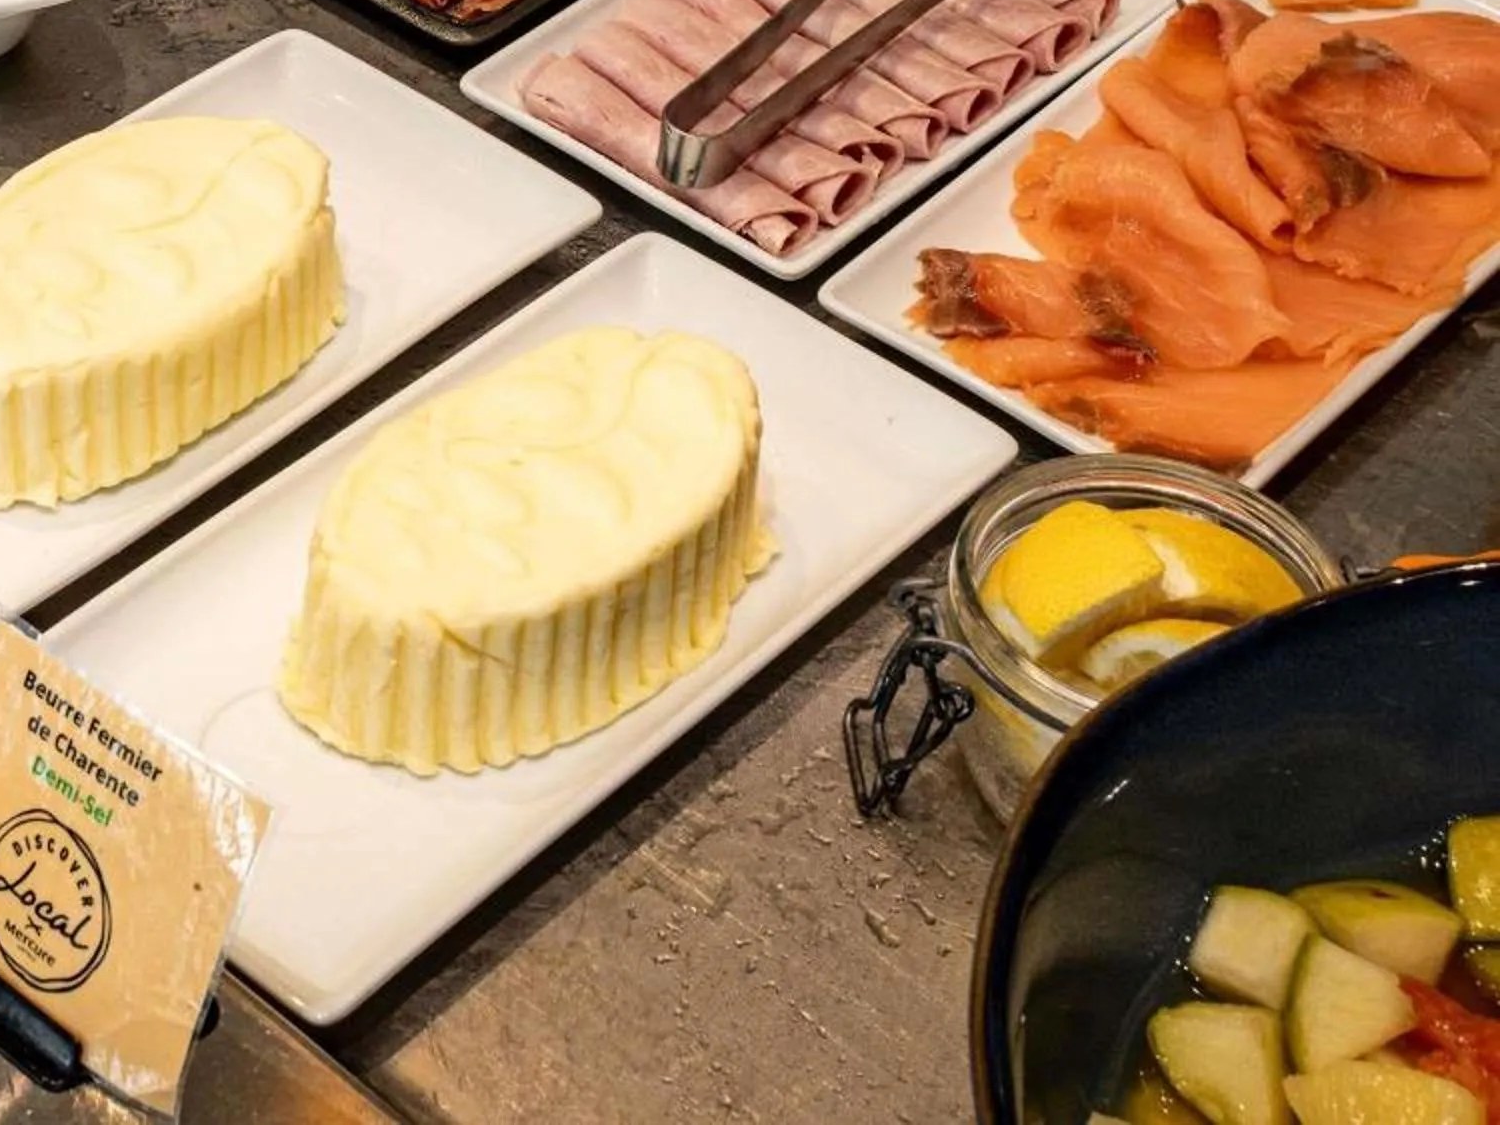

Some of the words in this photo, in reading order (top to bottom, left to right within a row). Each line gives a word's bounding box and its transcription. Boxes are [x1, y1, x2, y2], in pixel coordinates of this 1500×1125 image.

[22, 669, 85, 729] Beurre
[86, 716, 164, 783] Fermier
[26, 714, 51, 743] de
[54, 731, 141, 807] Charente
[31, 755, 114, 827] Demi-Sel
[12, 834, 94, 907] DISCOVER
[4, 918, 56, 968] Mercure
